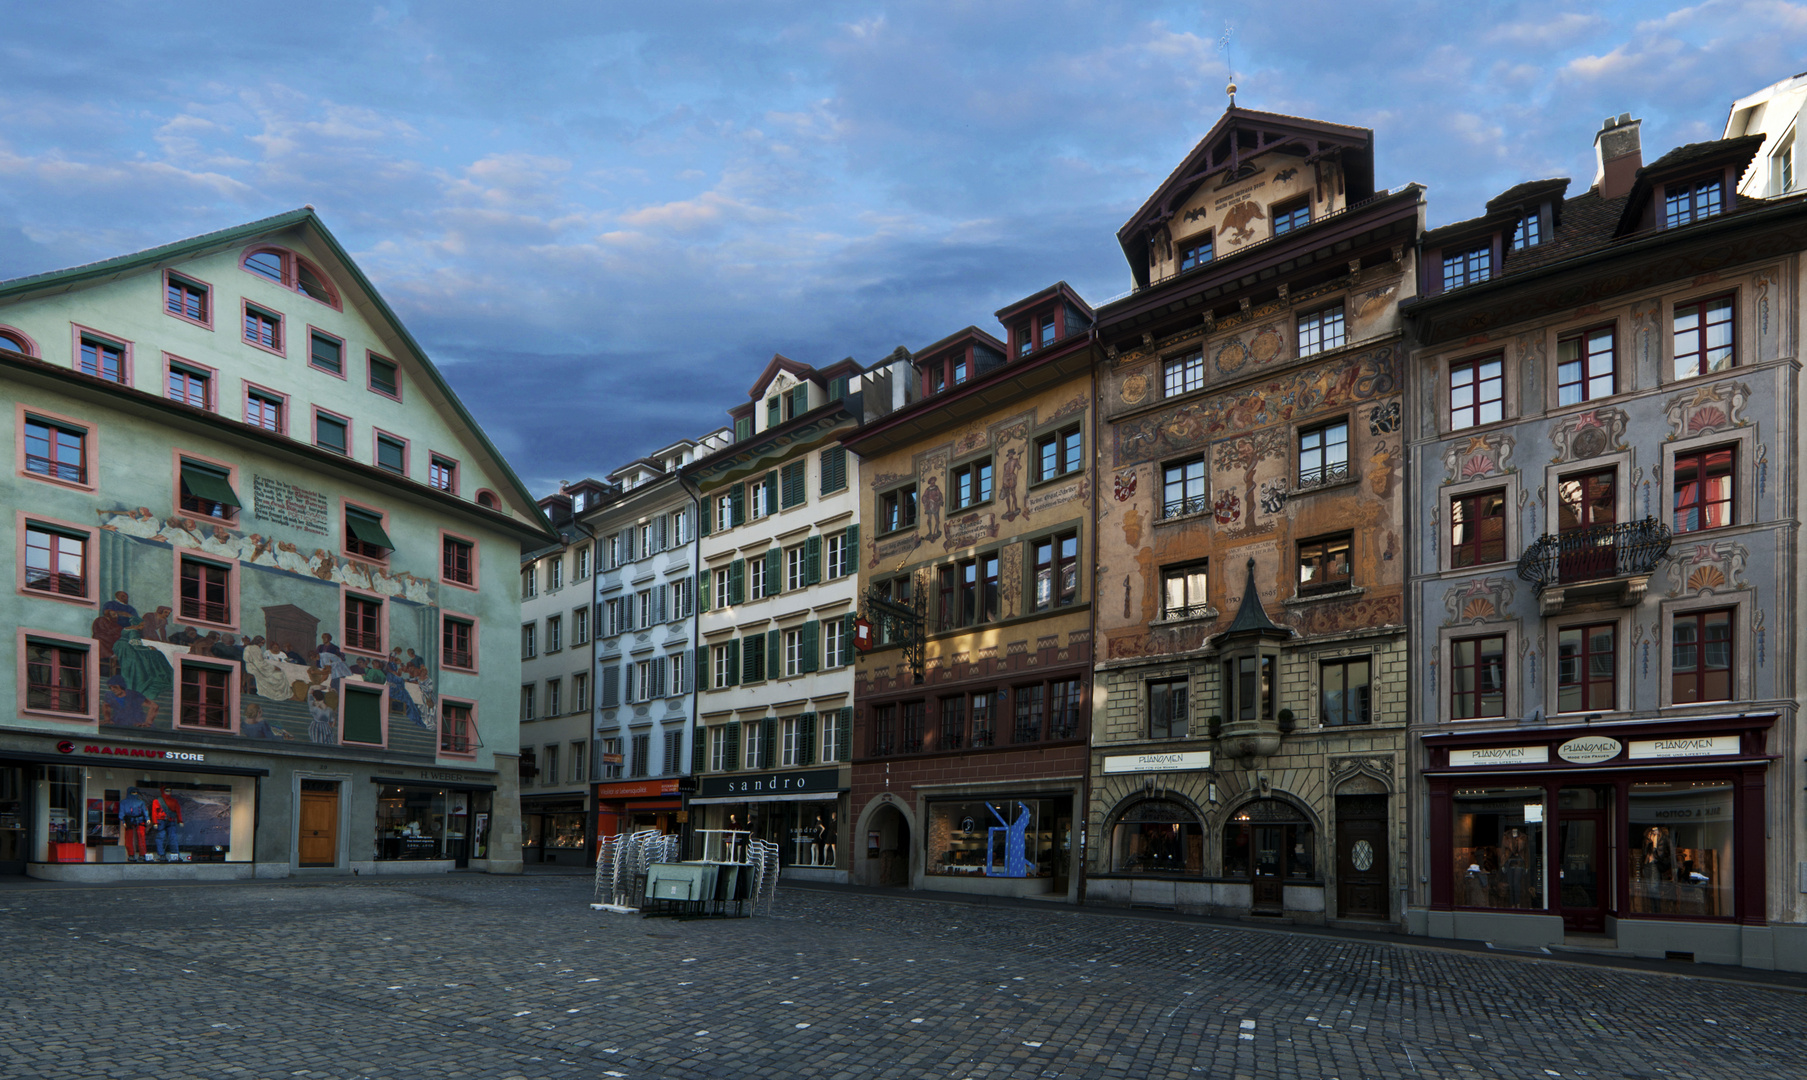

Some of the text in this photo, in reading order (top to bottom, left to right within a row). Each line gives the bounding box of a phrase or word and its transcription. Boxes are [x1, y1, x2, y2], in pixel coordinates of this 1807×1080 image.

[421, 771, 428, 779] H.
[431, 772, 463, 781] WEBER
[729, 775, 805, 792] sandro
